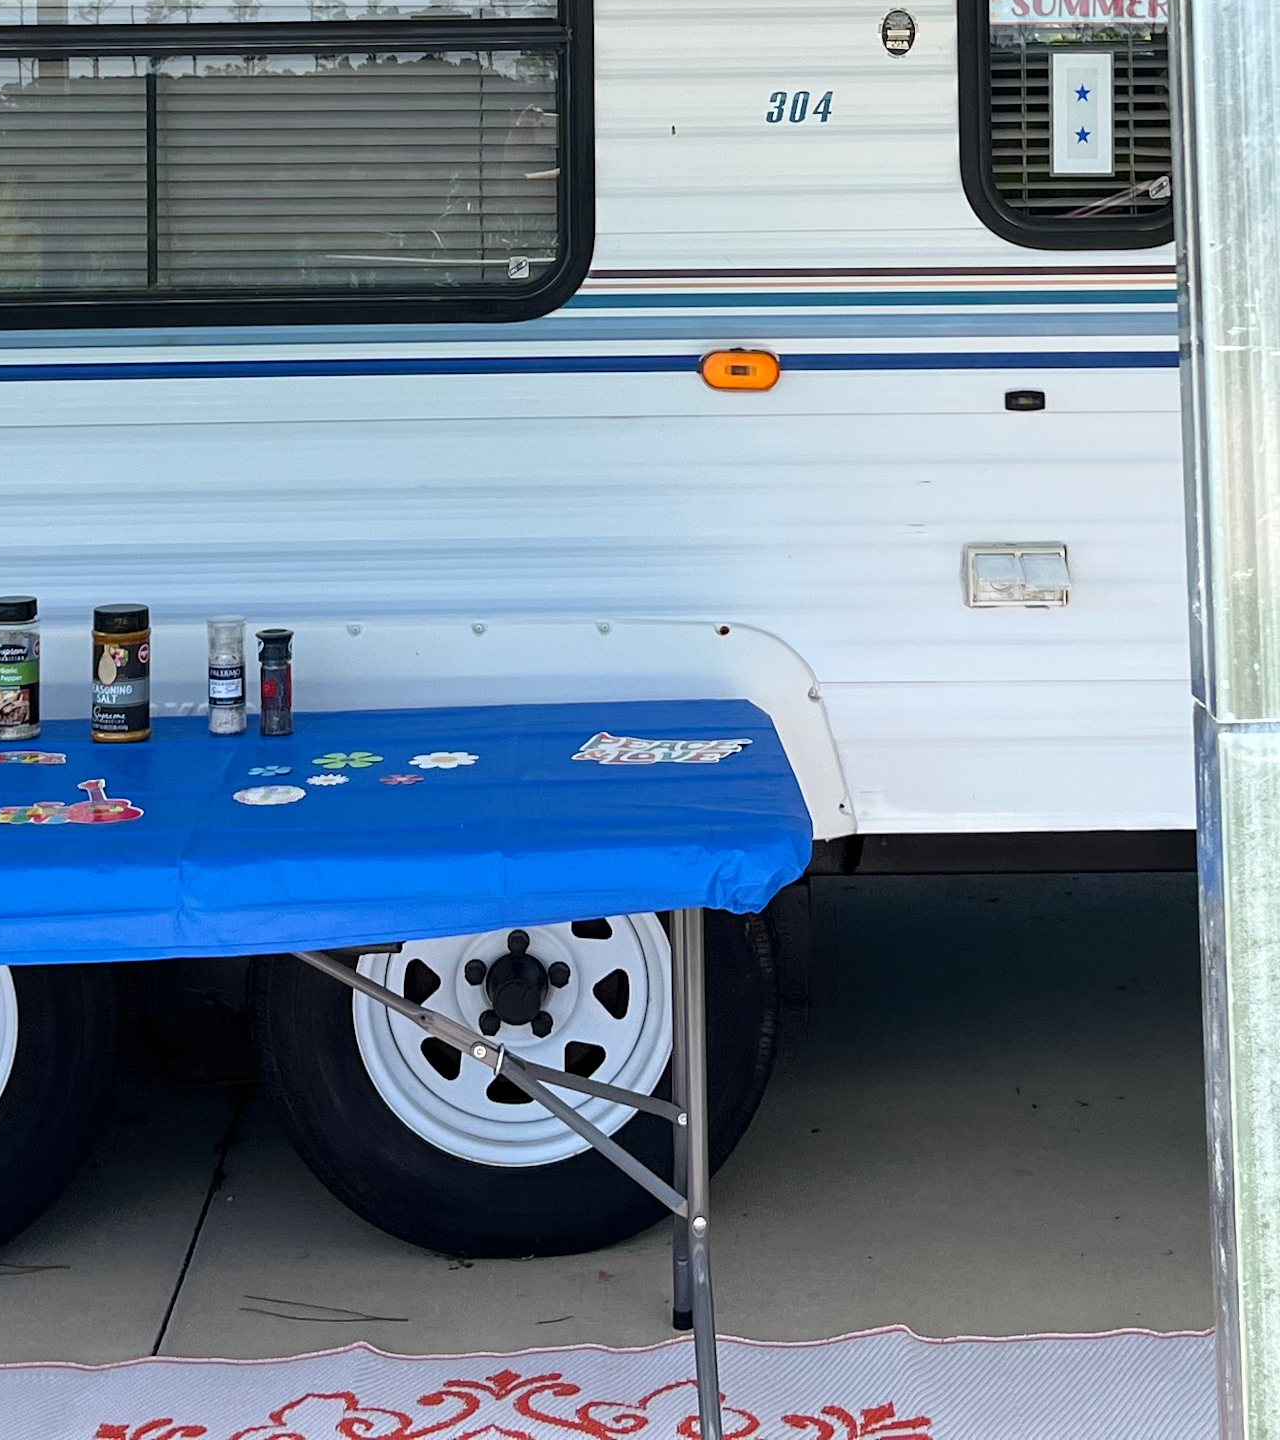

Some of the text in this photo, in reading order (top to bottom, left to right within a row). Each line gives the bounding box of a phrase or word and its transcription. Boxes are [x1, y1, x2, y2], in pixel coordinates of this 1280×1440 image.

[766, 90, 834, 123] 304
[96, 694, 118, 704] SALT
[579, 732, 753, 752] PEACE
